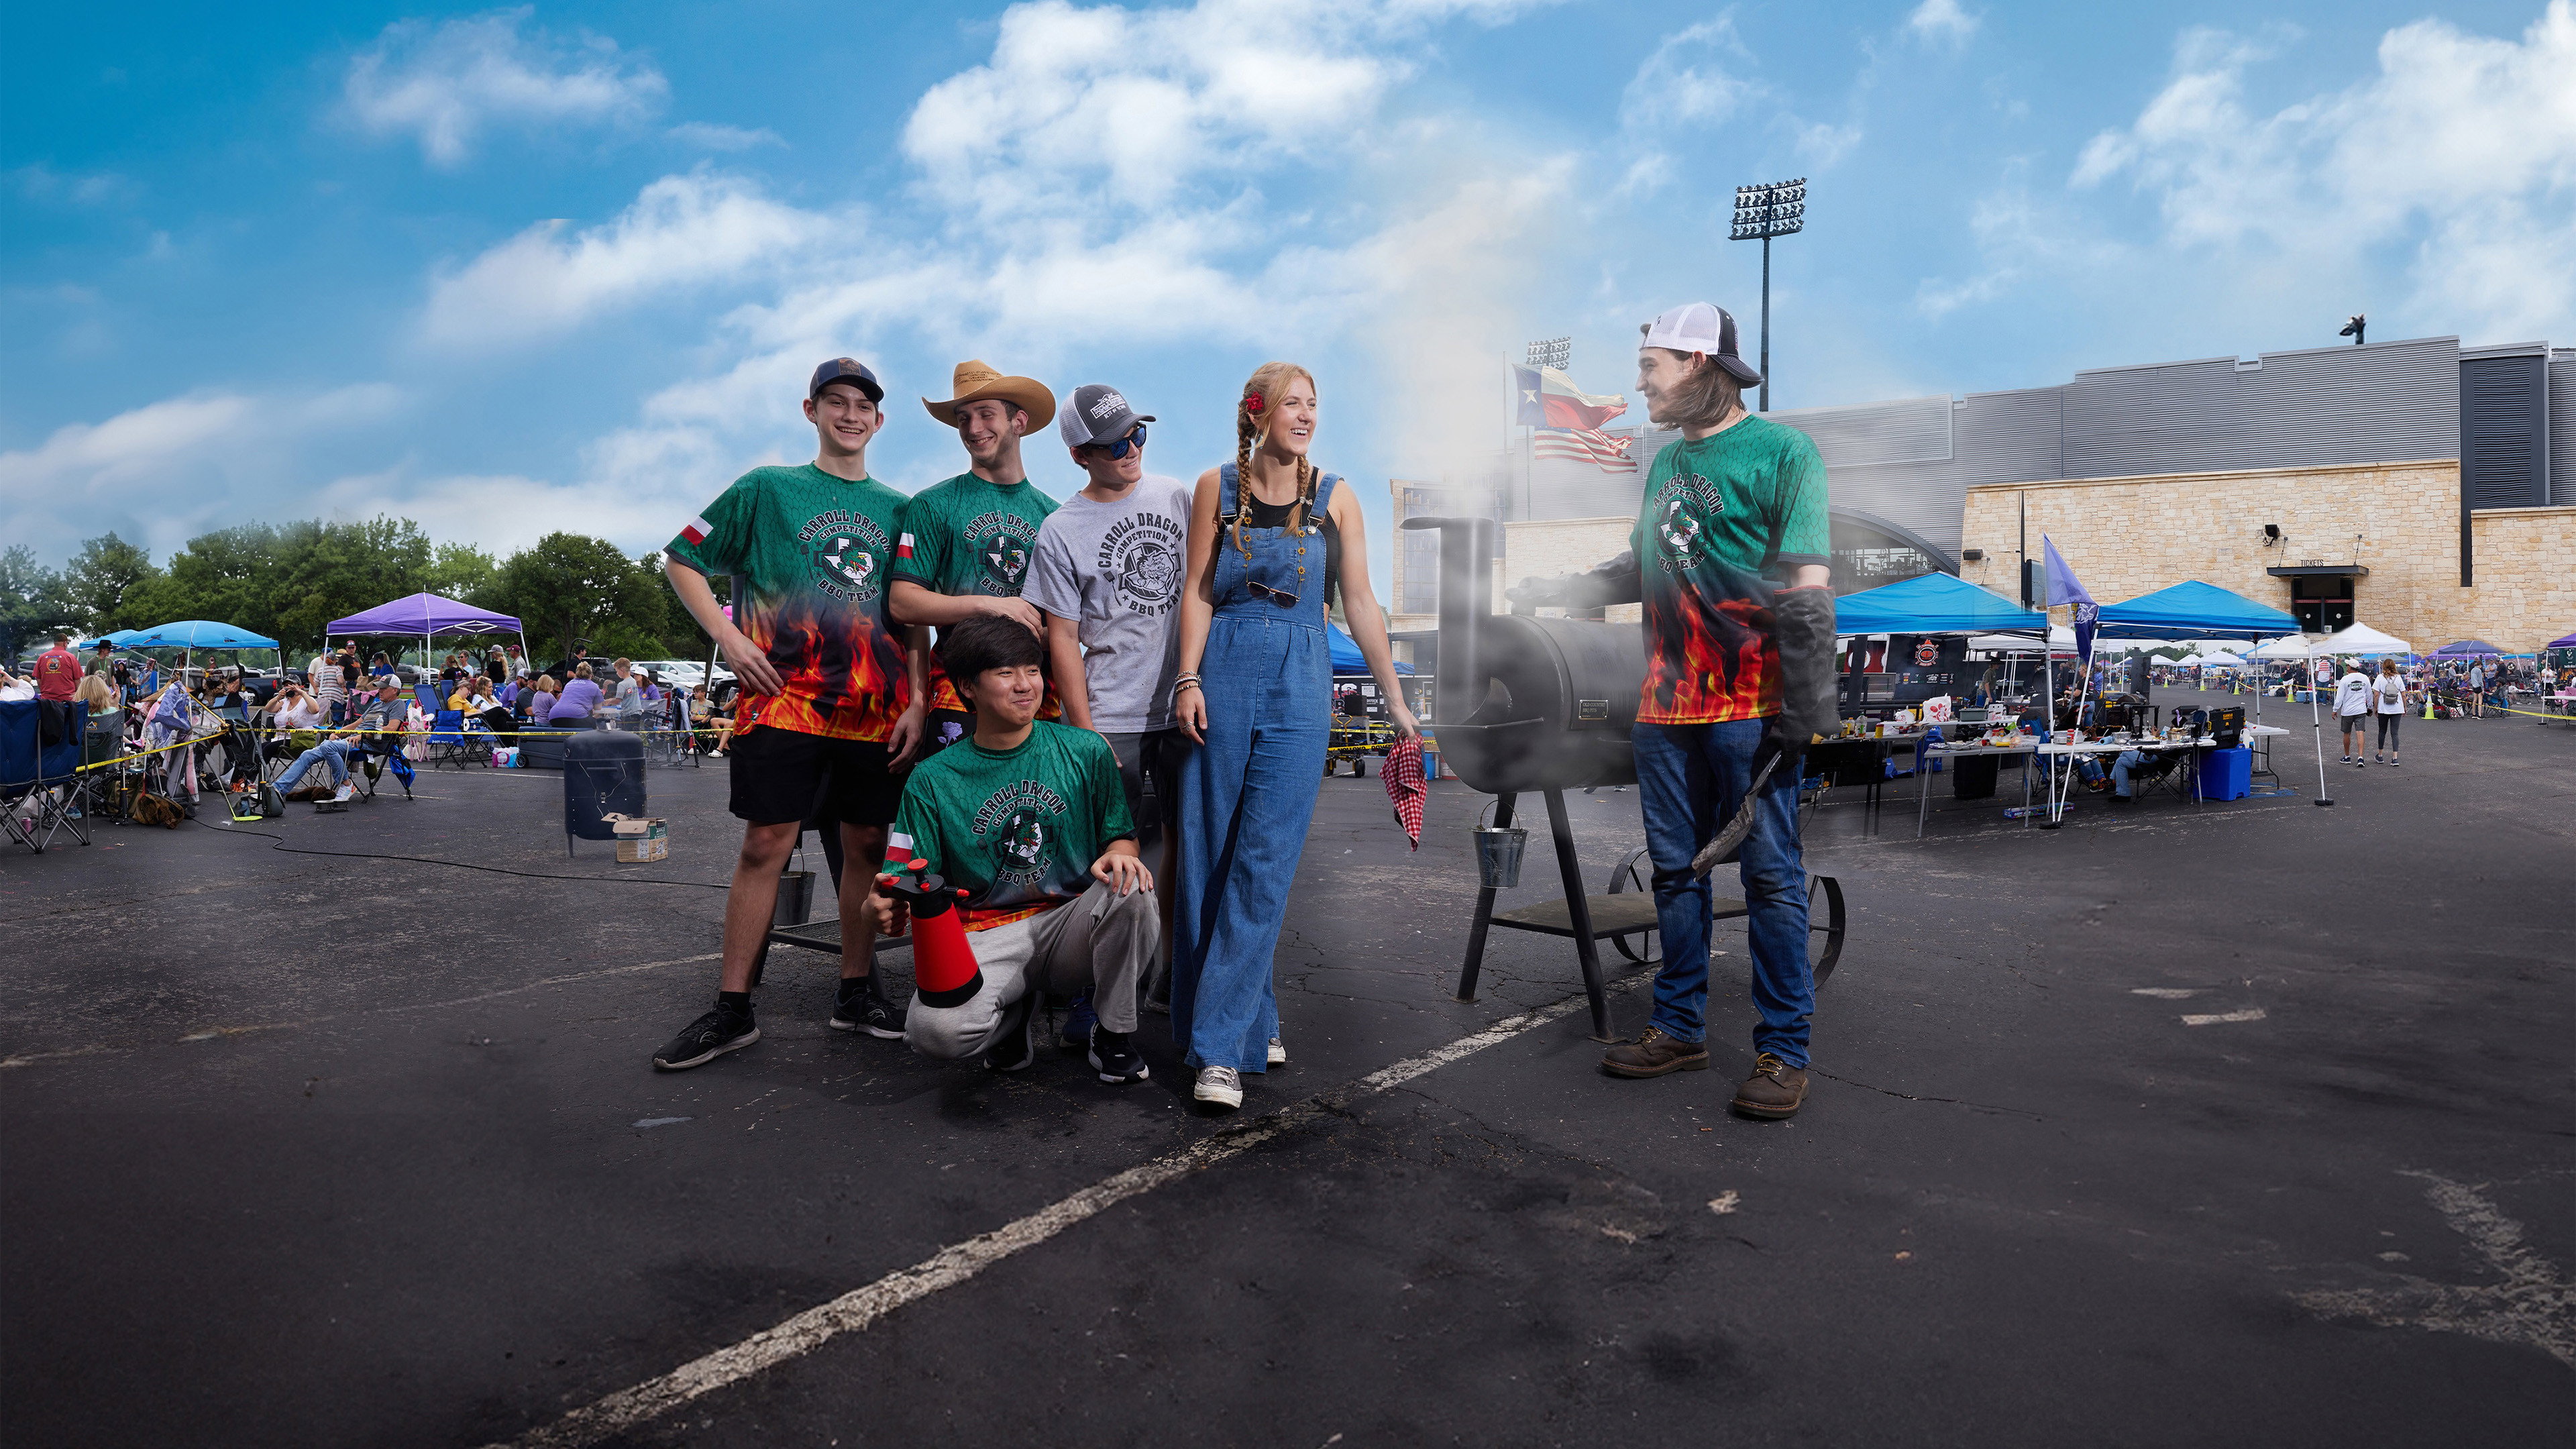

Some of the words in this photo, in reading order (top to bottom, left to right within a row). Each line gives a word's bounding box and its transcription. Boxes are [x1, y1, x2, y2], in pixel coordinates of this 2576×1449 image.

[1652, 472, 1690, 515] ARROLL
[1690, 472, 1724, 517] DRAGON
[1660, 487, 1707, 513] COMPETITION
[798, 509, 850, 542] CARROLL
[853, 511, 892, 553] DRAGON
[819, 525, 877, 547] COMPETITION
[963, 511, 1004, 541] CARROLL
[1007, 513, 1038, 541] DRAG
[983, 524, 1030, 545] COMPTITION
[1097, 517, 1135, 568] CARROLL
[1137, 513, 1184, 542] DRAGON
[1116, 530, 1169, 562] COMPETITION
[1674, 547, 1707, 573] TEAM
[2300, 559, 2324, 568] TICKETS
[817, 578, 844, 600] BBQ
[847, 585, 879, 602] TEAM
[980, 576, 1005, 597] BBQ
[1007, 584, 1024, 597] EA
[1128, 600, 1155, 617] BBQ
[1158, 586, 1182, 614] TEAM
[971, 782, 1019, 836] CARROLL
[1021, 779, 1068, 816] DRAGON
[998, 867, 1022, 886] BBQ
[1024, 856, 1053, 885] TEAM
